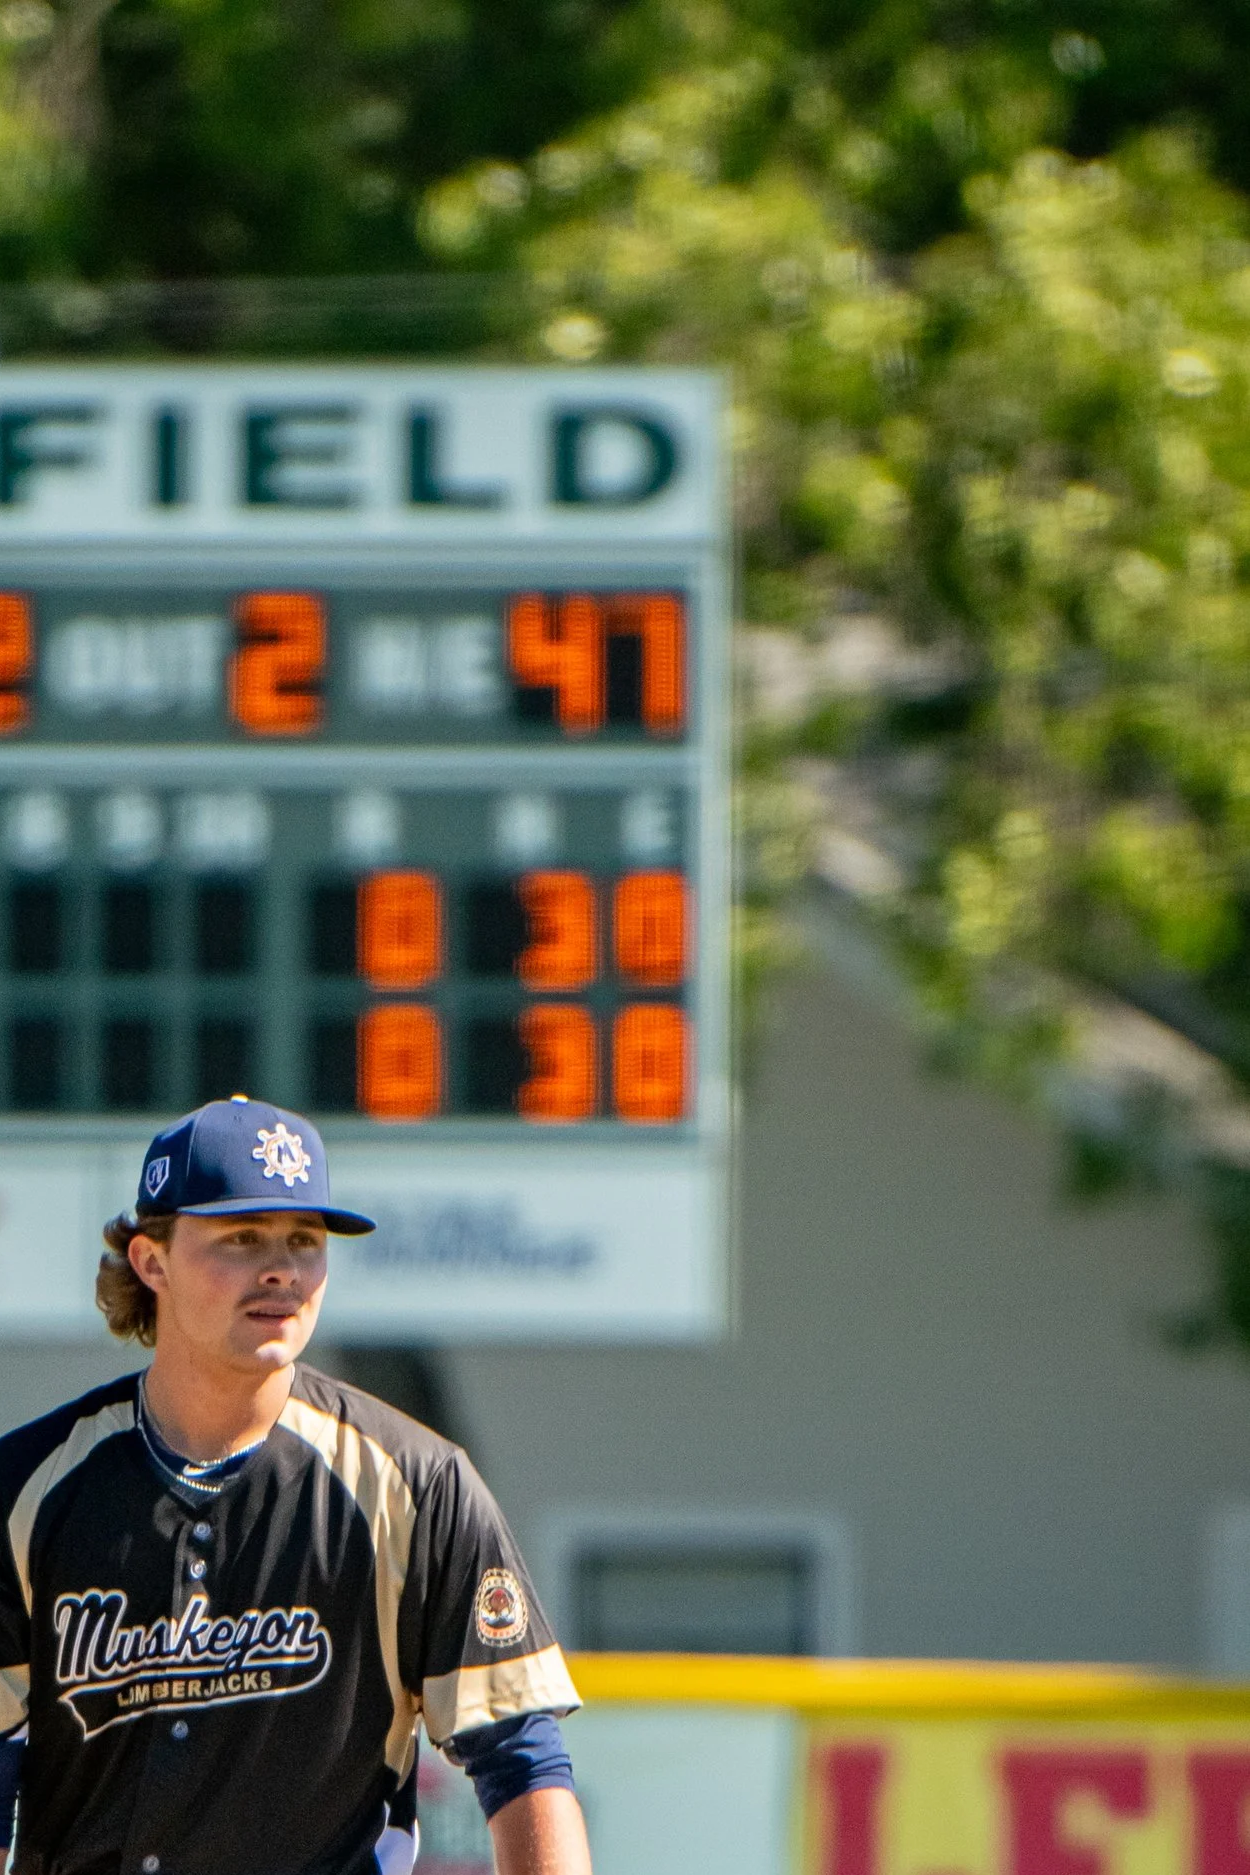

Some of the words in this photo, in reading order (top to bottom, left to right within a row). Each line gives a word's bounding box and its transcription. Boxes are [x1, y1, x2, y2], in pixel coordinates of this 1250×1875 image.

[47, 616, 226, 712] OUT
[231, 592, 327, 735] 2
[507, 594, 688, 736] 47
[359, 870, 443, 992] 0
[359, 1002, 443, 1123] 0
[54, 1588, 320, 1684] Muskegon
